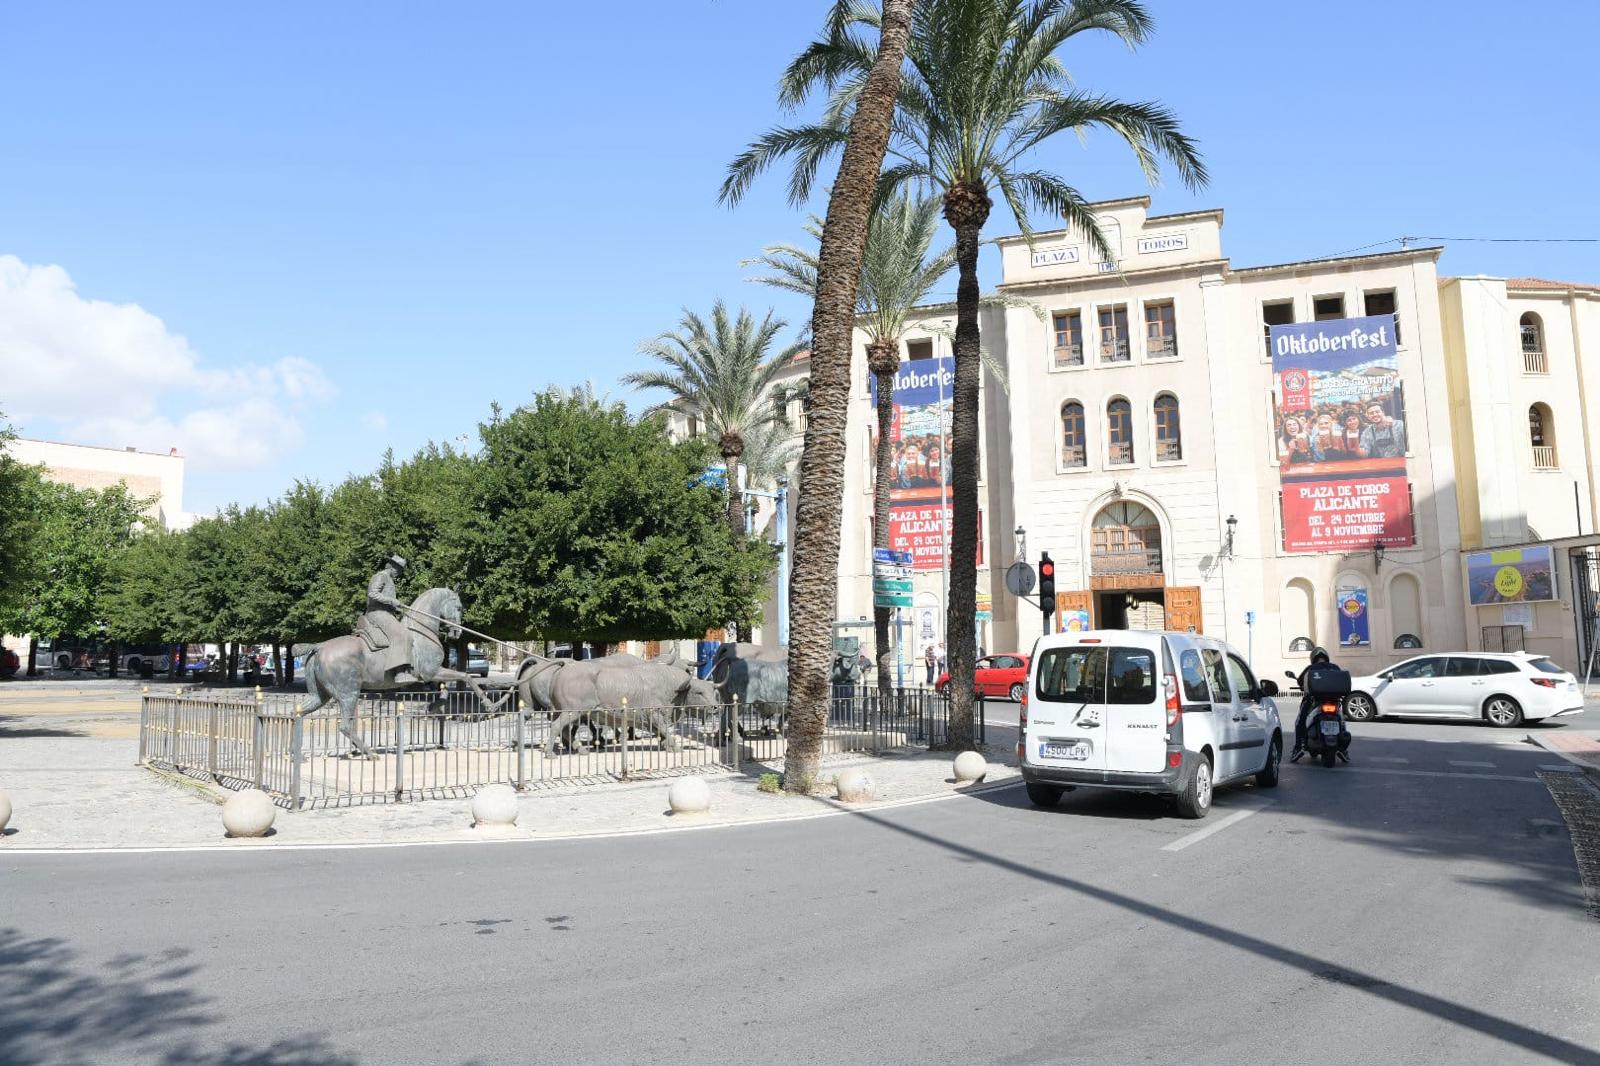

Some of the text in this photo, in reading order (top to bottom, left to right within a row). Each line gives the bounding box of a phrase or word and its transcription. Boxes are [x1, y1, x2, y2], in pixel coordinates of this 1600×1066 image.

[1141, 237, 1185, 251] TOROS
[1035, 251, 1075, 265] PLAZA
[1277, 326, 1389, 356] Oktoberfest
[1300, 483, 1390, 498] PLAZA DE TOROS
[1313, 496, 1378, 511] ALICANTE
[889, 511, 917, 521] PLAZA
[920, 510, 932, 520] DE
[1308, 512, 1385, 526] DEL 24 OCTUBRE
[1311, 524, 1384, 537] AL 9 NOVIEMBRE
[895, 537, 909, 547] DEL
[913, 536, 923, 546] 24
